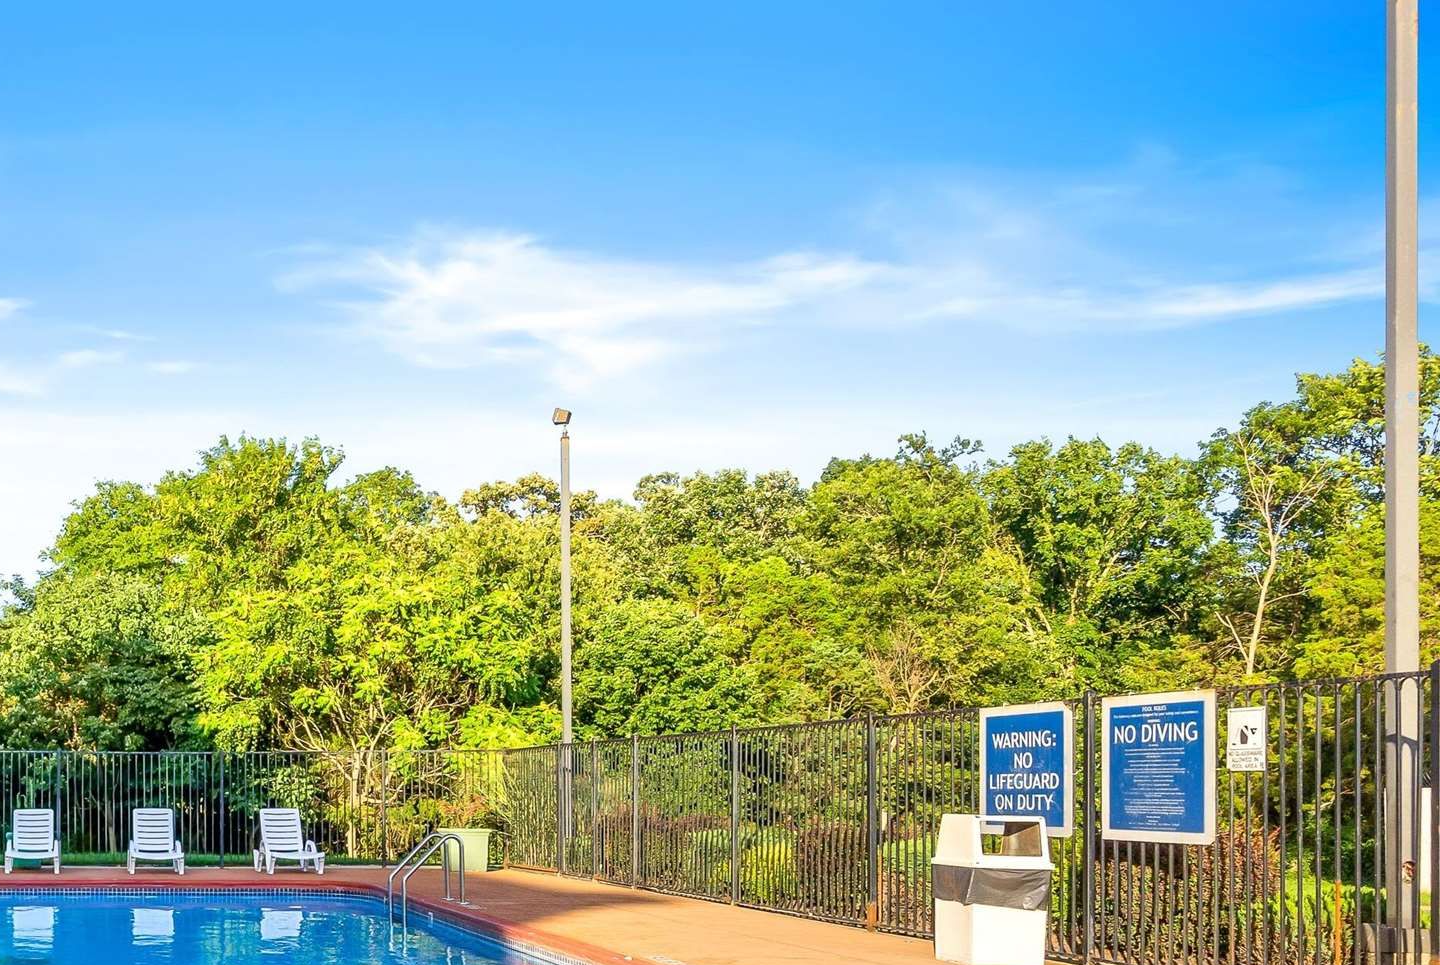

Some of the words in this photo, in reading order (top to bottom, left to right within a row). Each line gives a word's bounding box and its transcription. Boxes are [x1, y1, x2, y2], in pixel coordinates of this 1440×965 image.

[992, 730, 1057, 749] WARNING:
[1114, 724, 1137, 744] NO
[1141, 721, 1198, 743] DIVING
[1013, 752, 1033, 769] NO
[989, 773, 1060, 790] LIFEGUARD
[995, 794, 1013, 810] ON
[1017, 794, 1054, 811] DUTY
